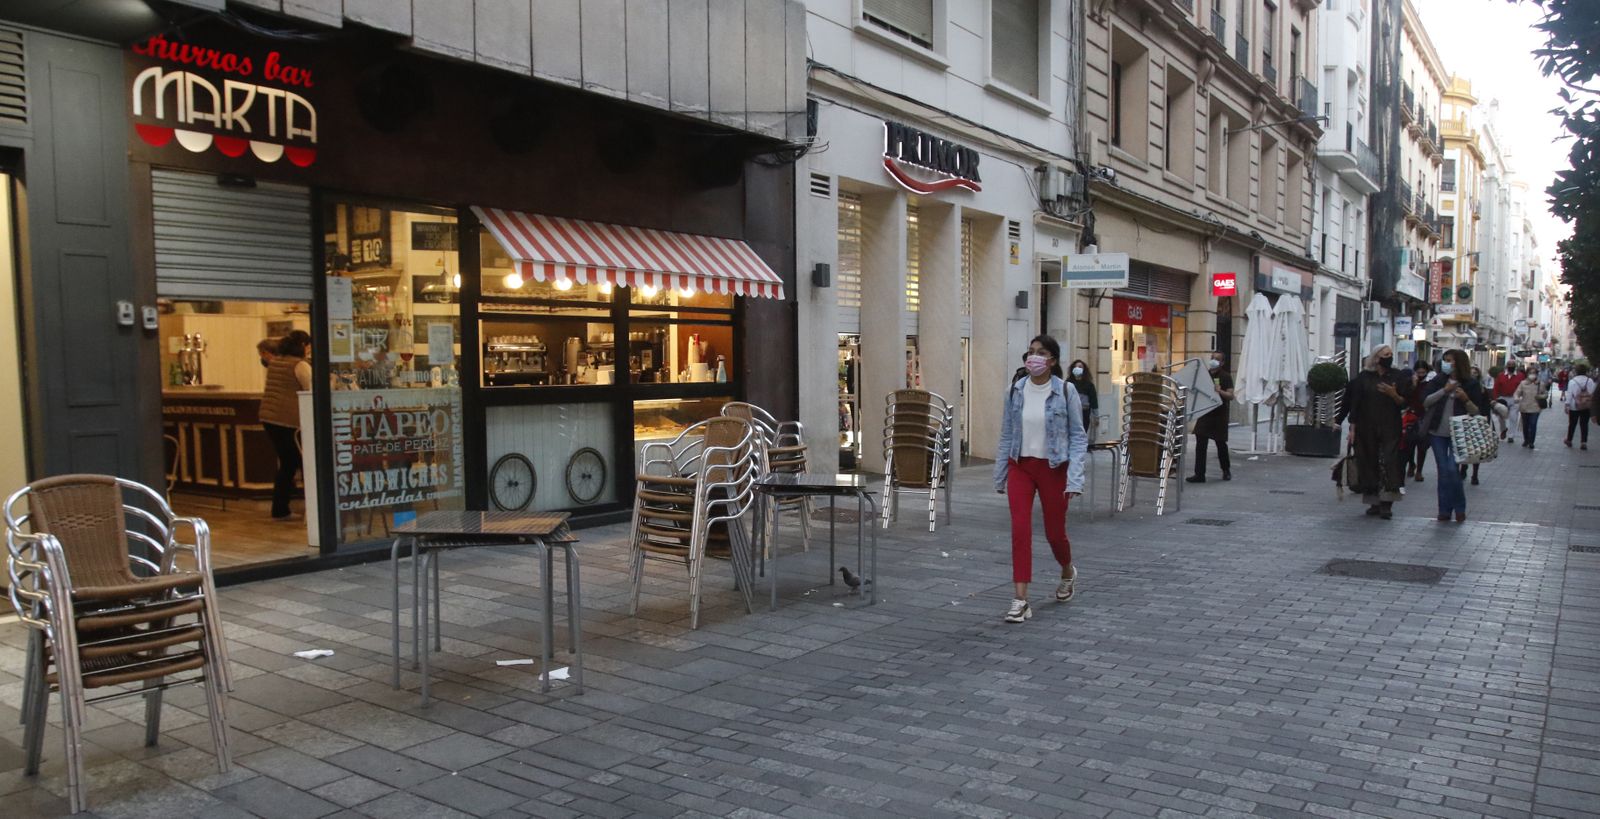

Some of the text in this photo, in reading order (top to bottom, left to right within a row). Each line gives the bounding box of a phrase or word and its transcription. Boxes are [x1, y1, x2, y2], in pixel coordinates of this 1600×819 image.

[264, 51, 314, 87] bar
[132, 66, 317, 143] MARTA
[882, 121, 982, 183] PRIMOR
[1214, 279, 1235, 287] GAES
[1127, 304, 1143, 320] GAES
[352, 409, 450, 441] TAPEO
[385, 442, 401, 451] DE
[338, 464, 449, 496] SANDWICHES
[339, 489, 425, 510] ensaladas
